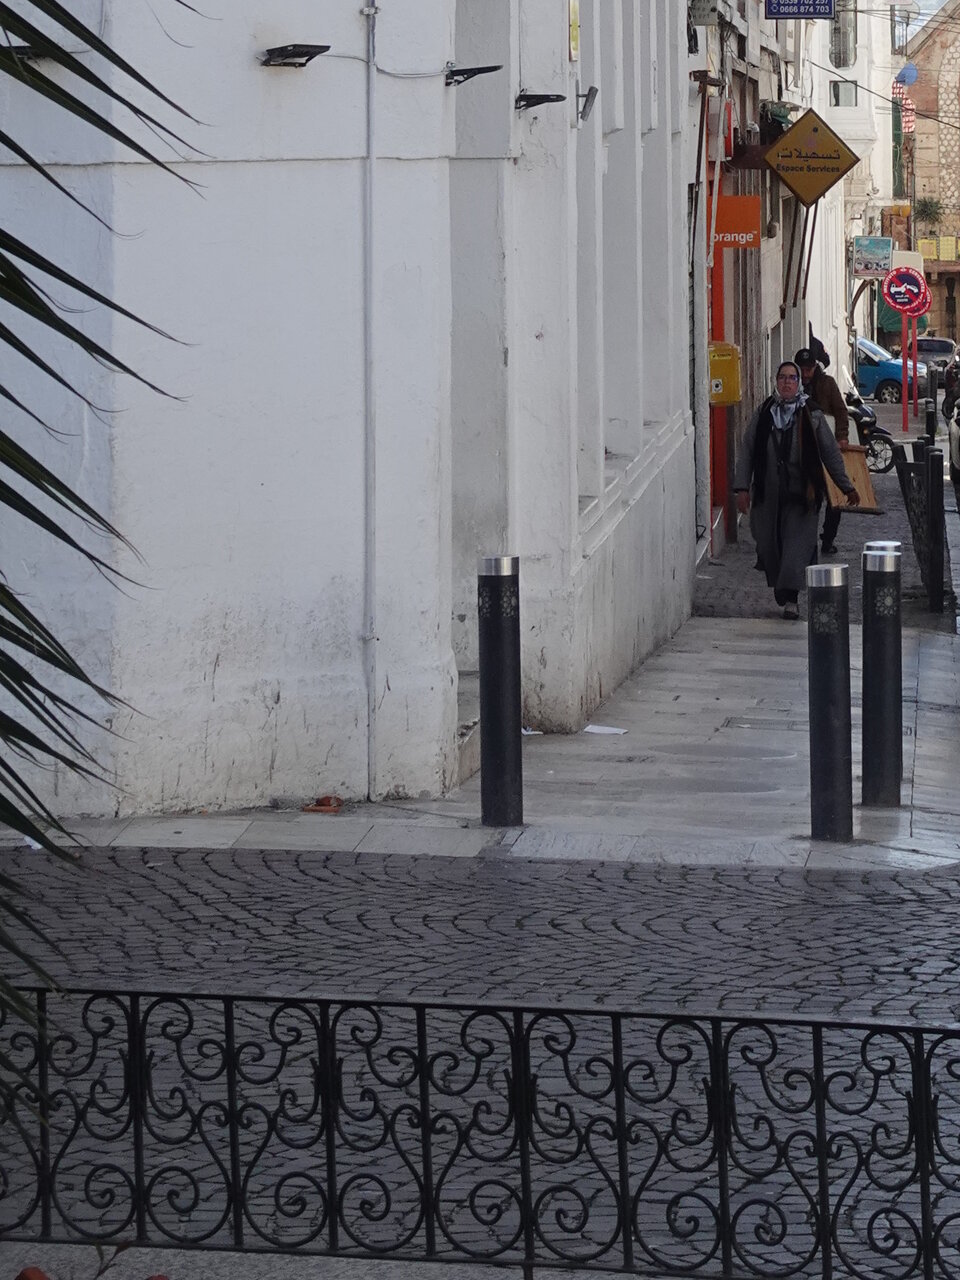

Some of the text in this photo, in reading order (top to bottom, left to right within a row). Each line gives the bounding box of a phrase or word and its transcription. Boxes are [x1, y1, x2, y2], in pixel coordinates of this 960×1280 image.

[800, 5, 814, 13] 874
[816, 5, 830, 13] 703
[776, 148, 841, 162] تسهيلات
[776, 164, 840, 173] Espace Services
[713, 232, 754, 244] orange
